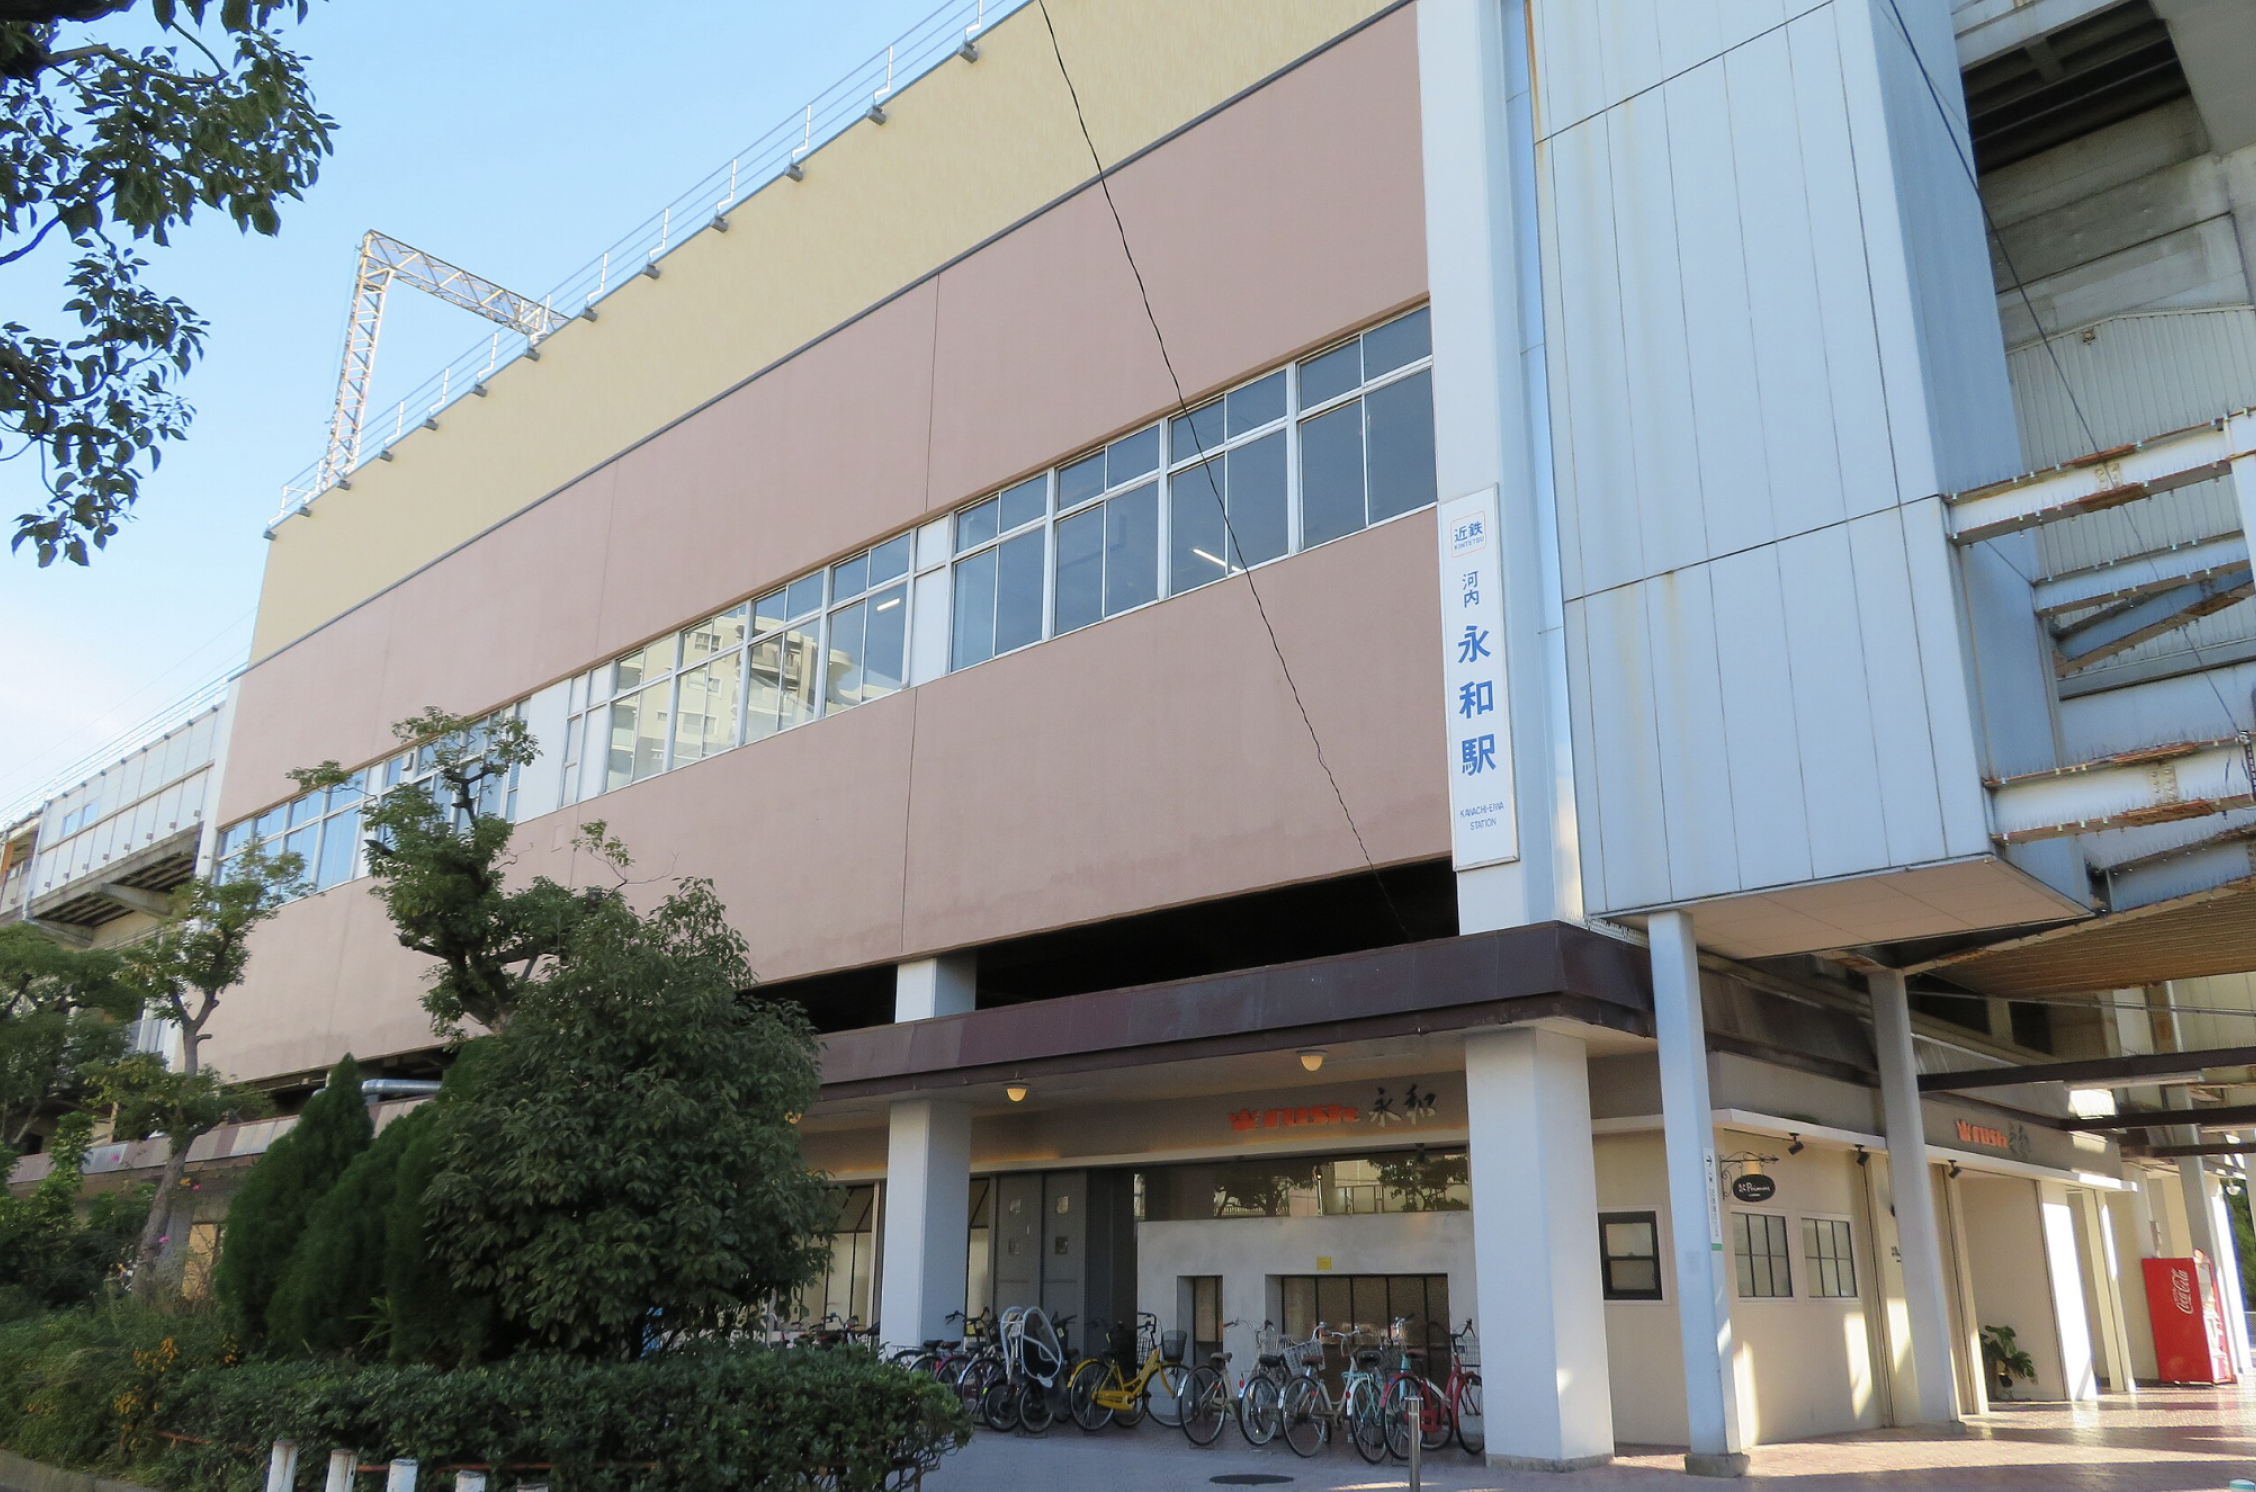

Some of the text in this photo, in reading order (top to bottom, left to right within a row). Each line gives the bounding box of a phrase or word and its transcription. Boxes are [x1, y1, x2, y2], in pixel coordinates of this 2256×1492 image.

[1454, 521, 1484, 542] 近鉄
[1454, 536, 1485, 550] KINTETSU
[1460, 801, 1504, 818] KAWACHI-EIWA
[1470, 817, 1497, 831] STATION
[1368, 1084, 1438, 1128] 永和
